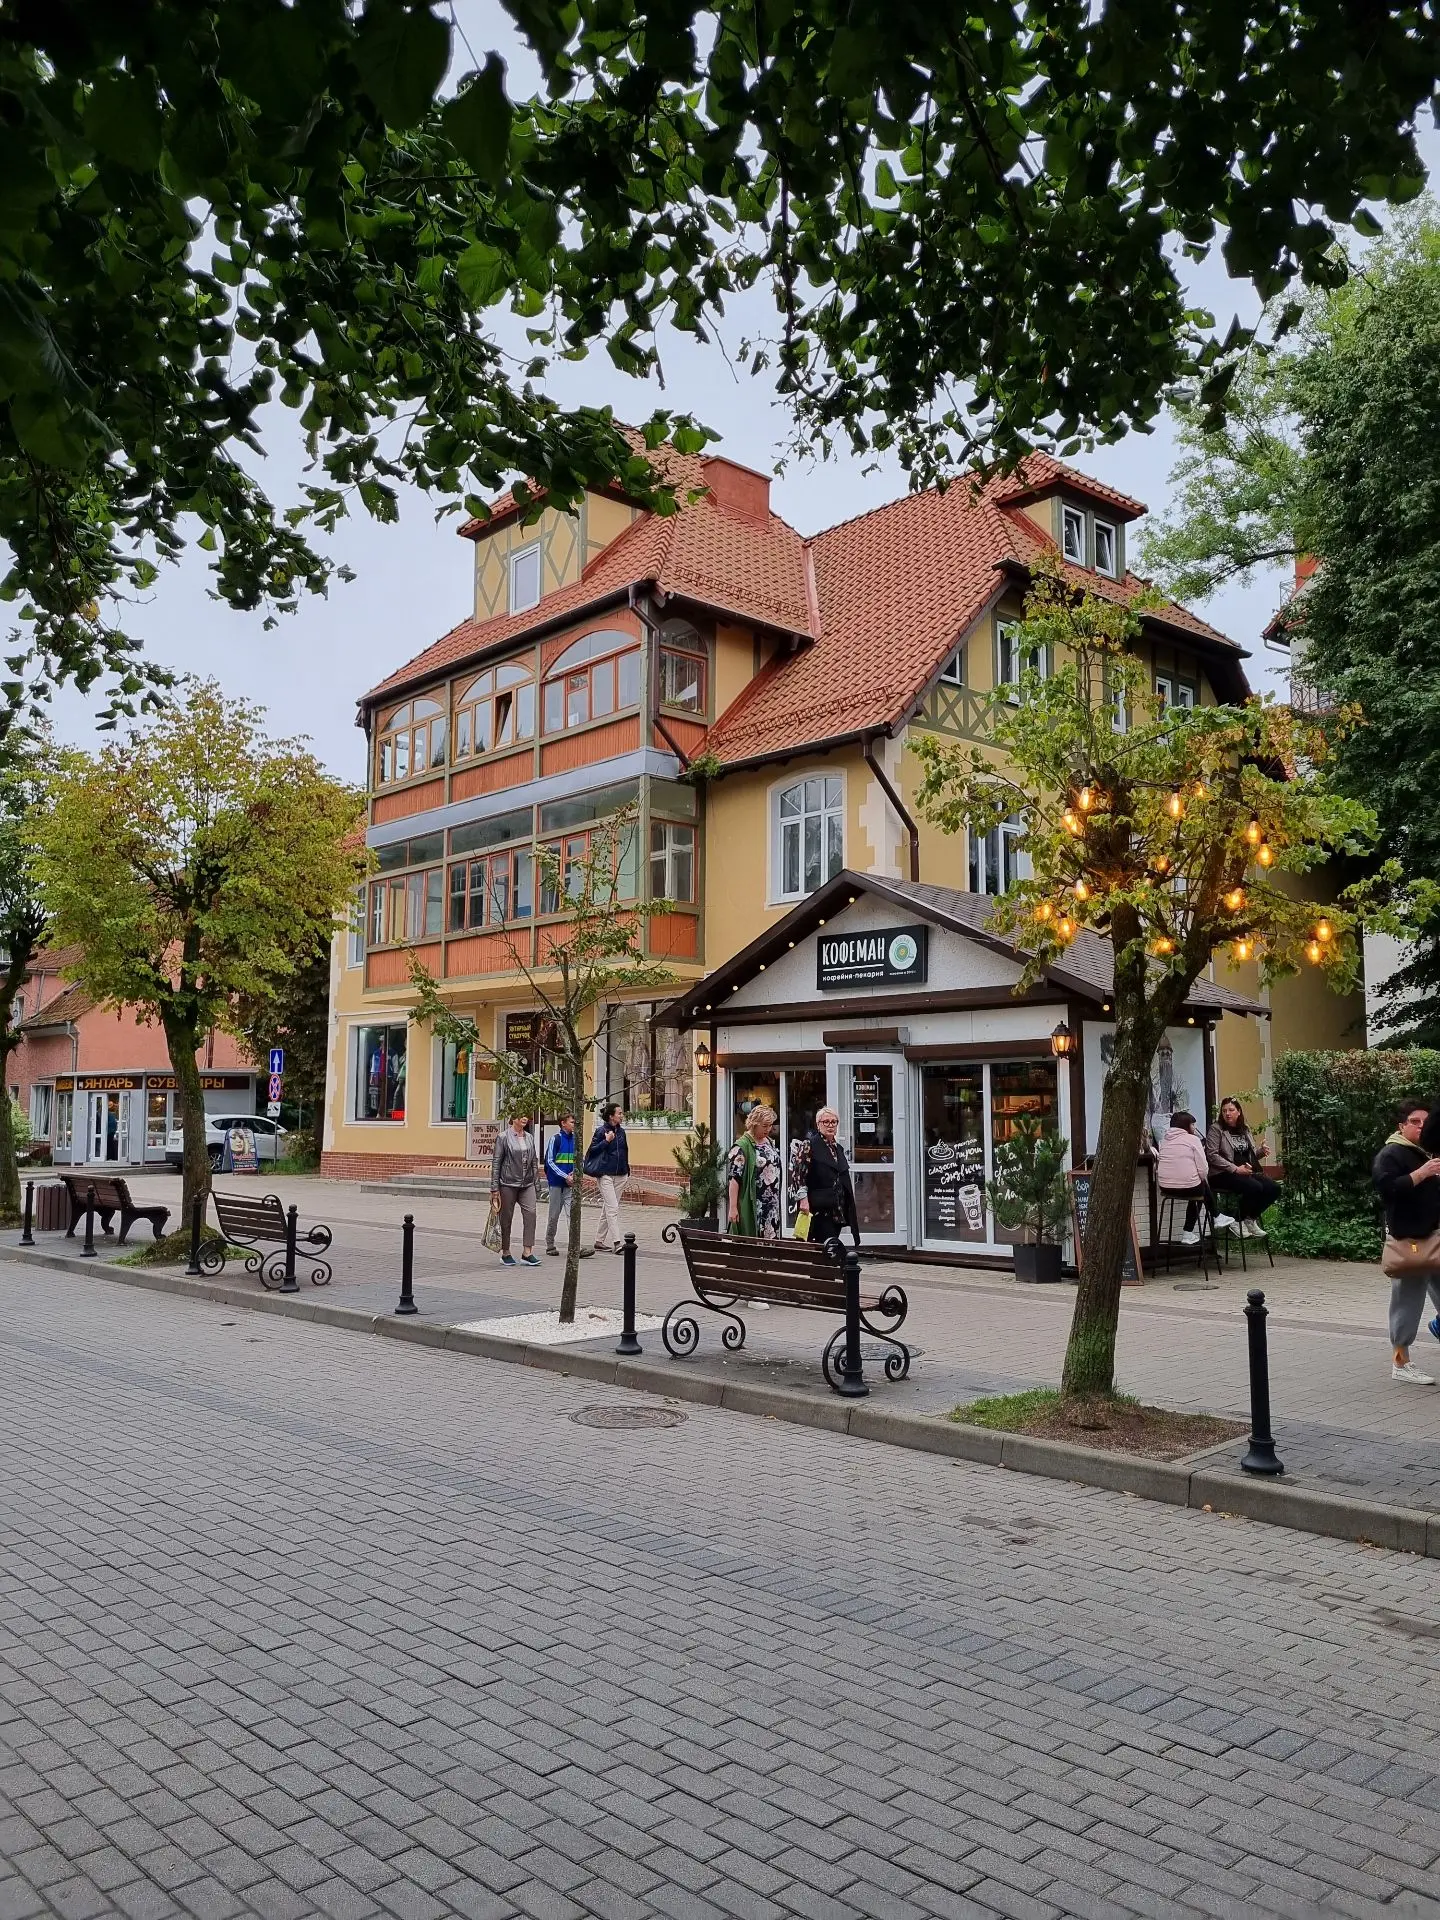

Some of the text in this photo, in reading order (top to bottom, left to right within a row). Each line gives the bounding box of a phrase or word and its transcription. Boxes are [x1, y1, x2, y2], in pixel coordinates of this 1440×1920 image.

[822, 937, 885, 966] КОФЕМАН
[822, 970, 884, 982] кофейня-пекарня
[84, 1077, 133, 1089] ЯНТАРЬ
[147, 1077, 225, 1089] СУВРЫ
